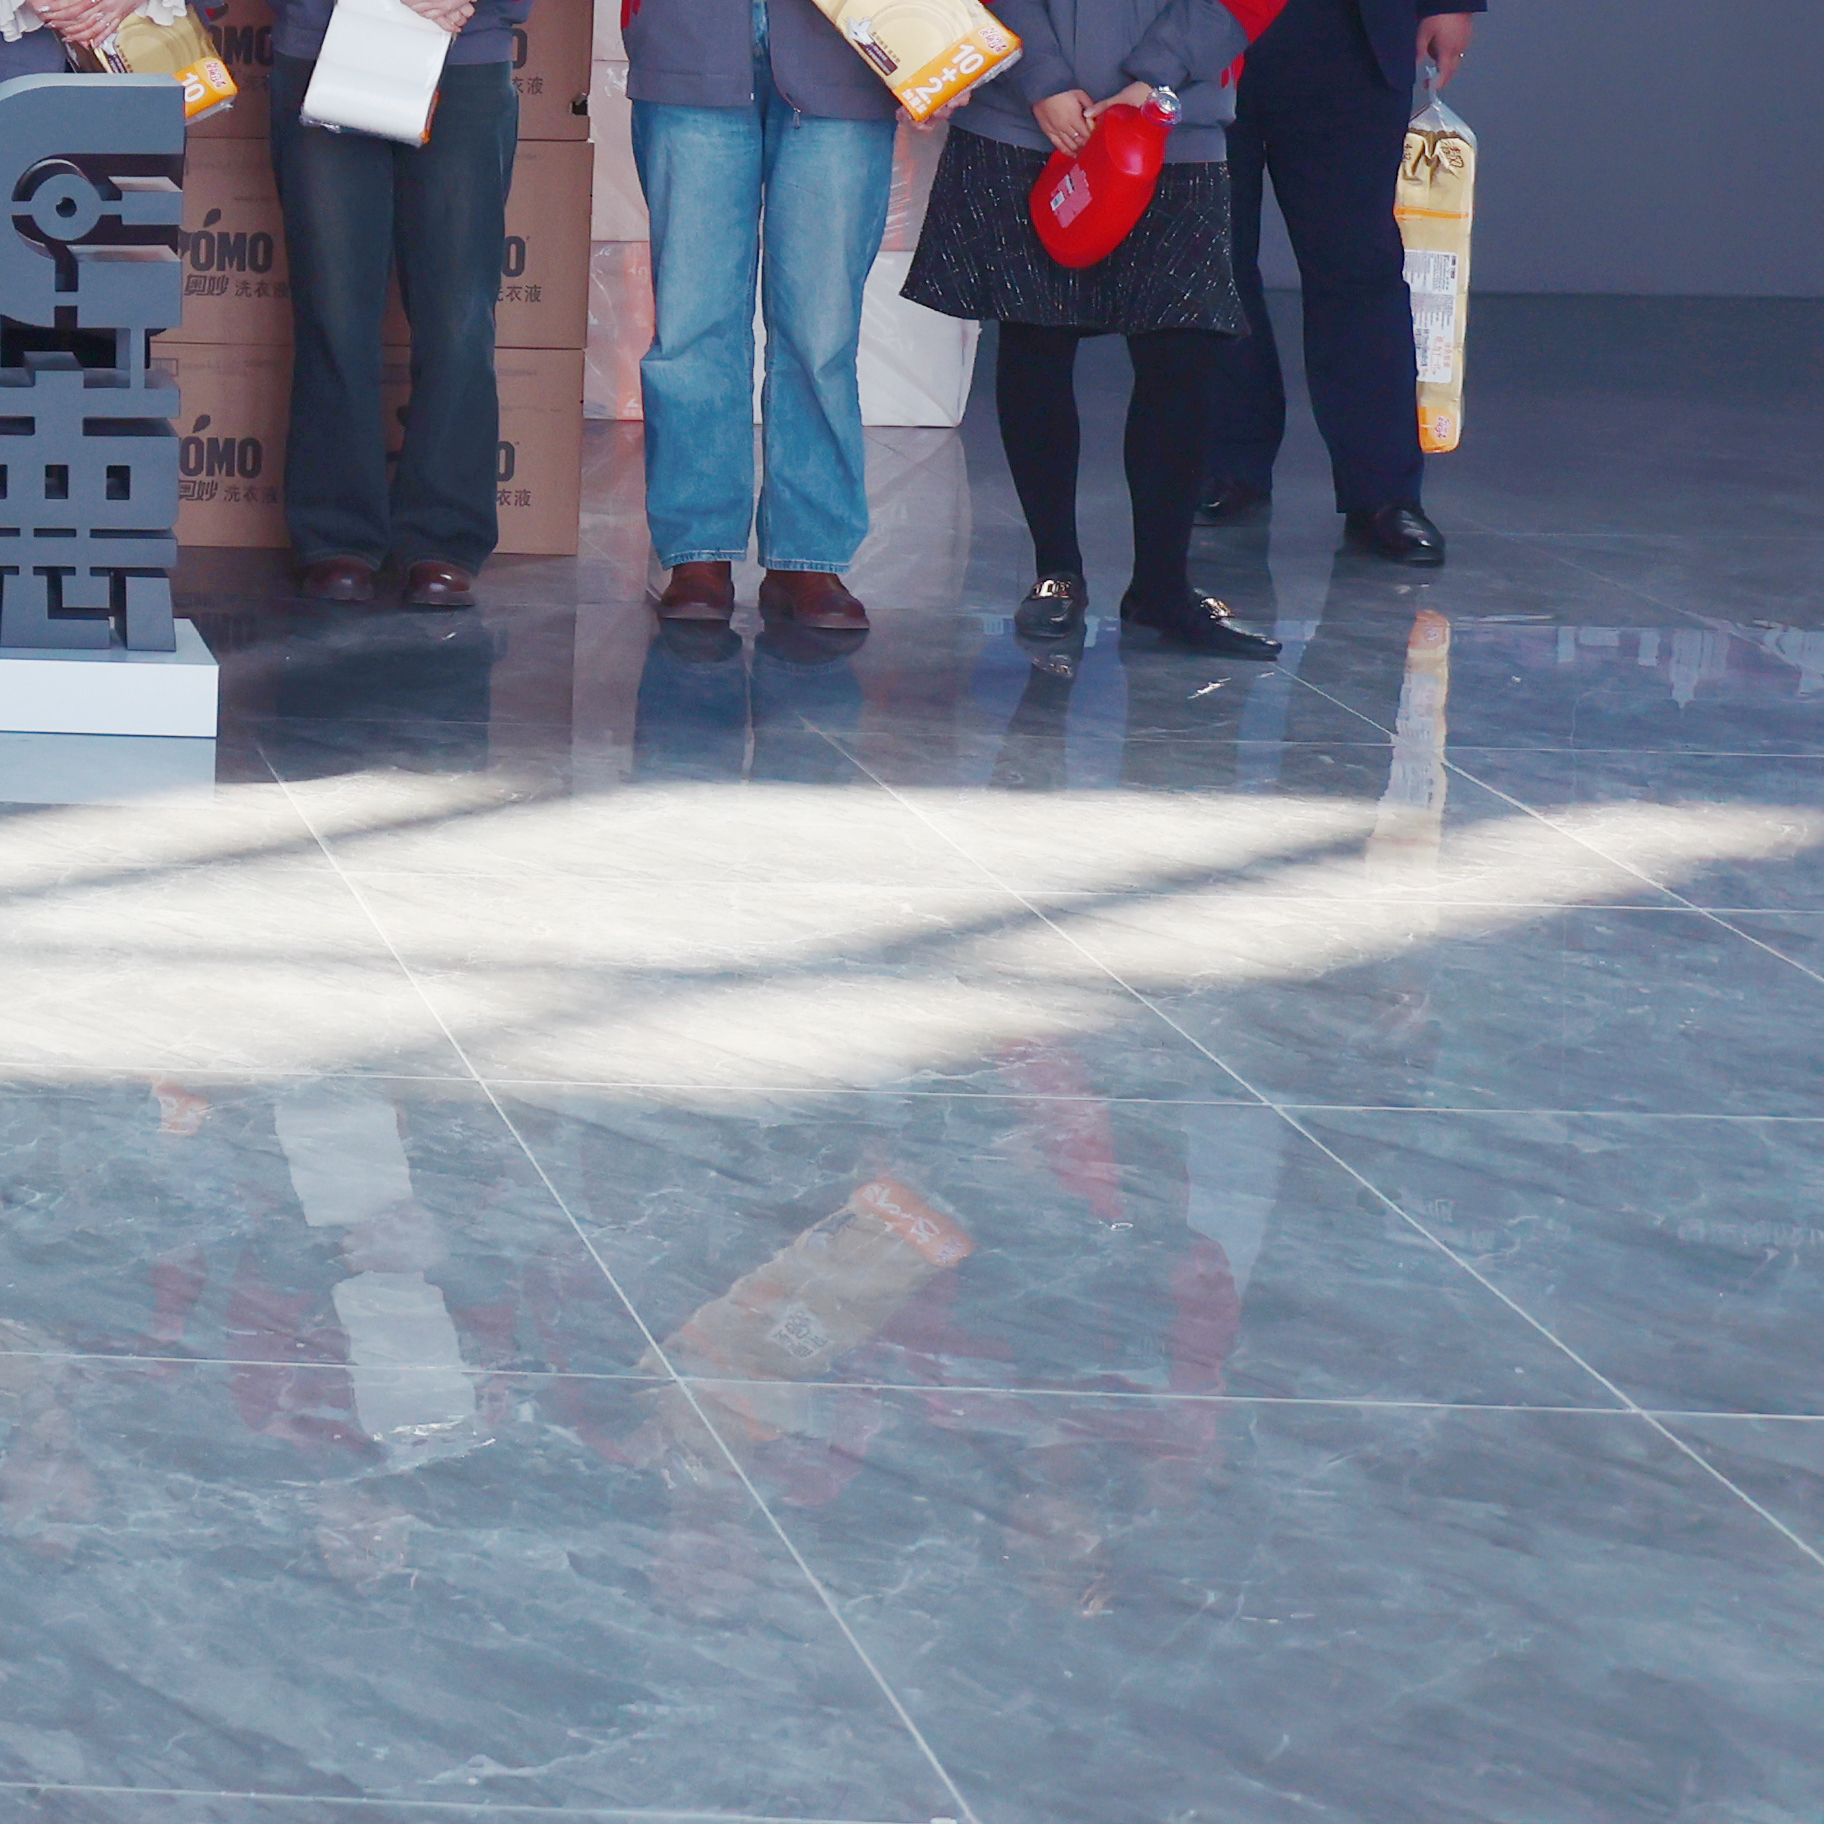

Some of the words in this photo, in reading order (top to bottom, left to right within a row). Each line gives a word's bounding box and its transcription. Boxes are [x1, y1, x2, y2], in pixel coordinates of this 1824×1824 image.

[183, 71, 206, 103] 10
[190, 232, 273, 274] OMO
[183, 275, 228, 297] 奥妙
